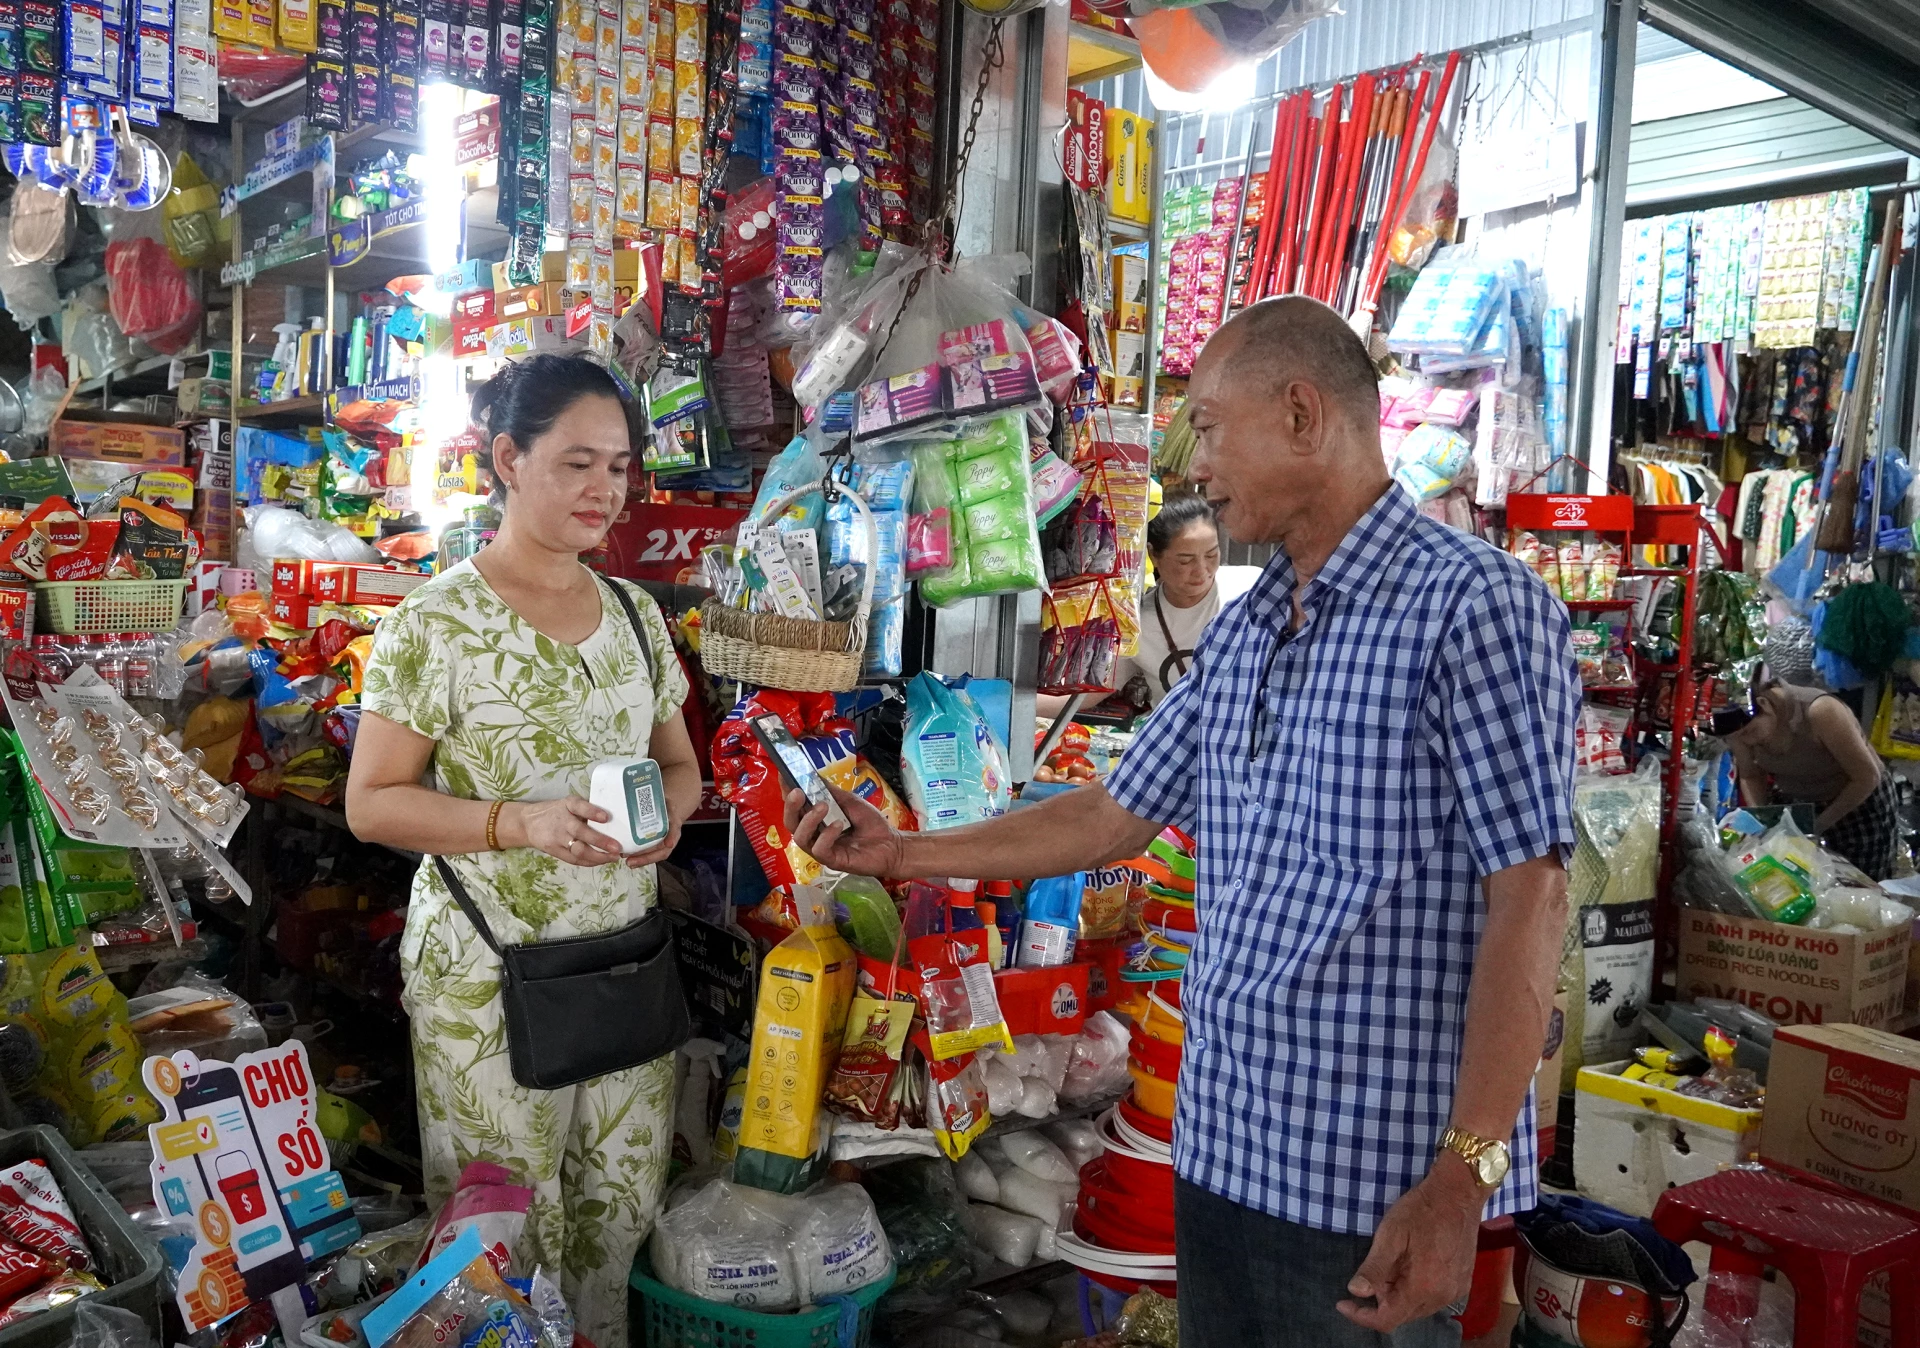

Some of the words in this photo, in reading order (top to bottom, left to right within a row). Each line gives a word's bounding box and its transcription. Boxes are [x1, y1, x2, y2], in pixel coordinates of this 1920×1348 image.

[24, 12, 56, 24] CLEAR
[742, 15, 769, 30] Downy
[75, 27, 94, 36] Dove
[781, 33, 813, 50] Downy
[143, 51, 162, 60] Dove
[180, 67, 198, 77] Dove
[740, 65, 769, 79] Downy
[22, 85, 53, 97] CLEAR
[781, 82, 815, 98] Downy
[781, 127, 817, 143] Downy
[457, 142, 487, 162] ChocoPie
[1087, 107, 1101, 184] ChocoPie
[783, 174, 819, 188] Downy
[398, 209, 413, 222] CHO
[783, 223, 819, 238] Downy
[220, 259, 256, 284] closeup
[783, 276, 820, 291] Downy
[462, 331, 486, 344] CHOCOLAT
[509, 329, 525, 347] Tipo
[374, 385, 388, 398] TIM
[388, 382, 408, 399] MẠCH
[960, 462, 997, 480] Peppy
[437, 474, 464, 490] Custas
[968, 509, 999, 529] Peppy
[640, 529, 699, 562] 2X
[977, 549, 1009, 567] Peppy
[55, 567, 71, 578] Xúc
[71, 558, 92, 570] xích
[69, 569, 88, 580] dinh
[89, 911, 100, 919] 100
[106, 932, 127, 942] uỳnh
[128, 932, 142, 941] Anh
[1692, 920, 1743, 940] BÁNH
[1749, 926, 1791, 948] PHỞ
[1795, 935, 1840, 956] KHÔ
[1707, 939, 1745, 959] BÔNG
[1747, 944, 1776, 963] LÚA
[1779, 949, 1819, 971] VÀNG
[1686, 953, 1729, 971] DRIED
[1731, 959, 1765, 977] RICE
[1768, 969, 1841, 991] NOODLES
[1712, 983, 1825, 1026] VIFON
[1852, 1000, 1886, 1025] VIFON
[244, 1049, 310, 1105] CHỢ
[1828, 1066, 1905, 1101] Cholimex
[1820, 1108, 1879, 1139] TƯƠNG
[277, 1110, 324, 1177] SỐ
[1815, 1161, 1840, 1180] CHAI
[1843, 1172, 1864, 1188] PET
[12, 1171, 56, 1204] Omachi
